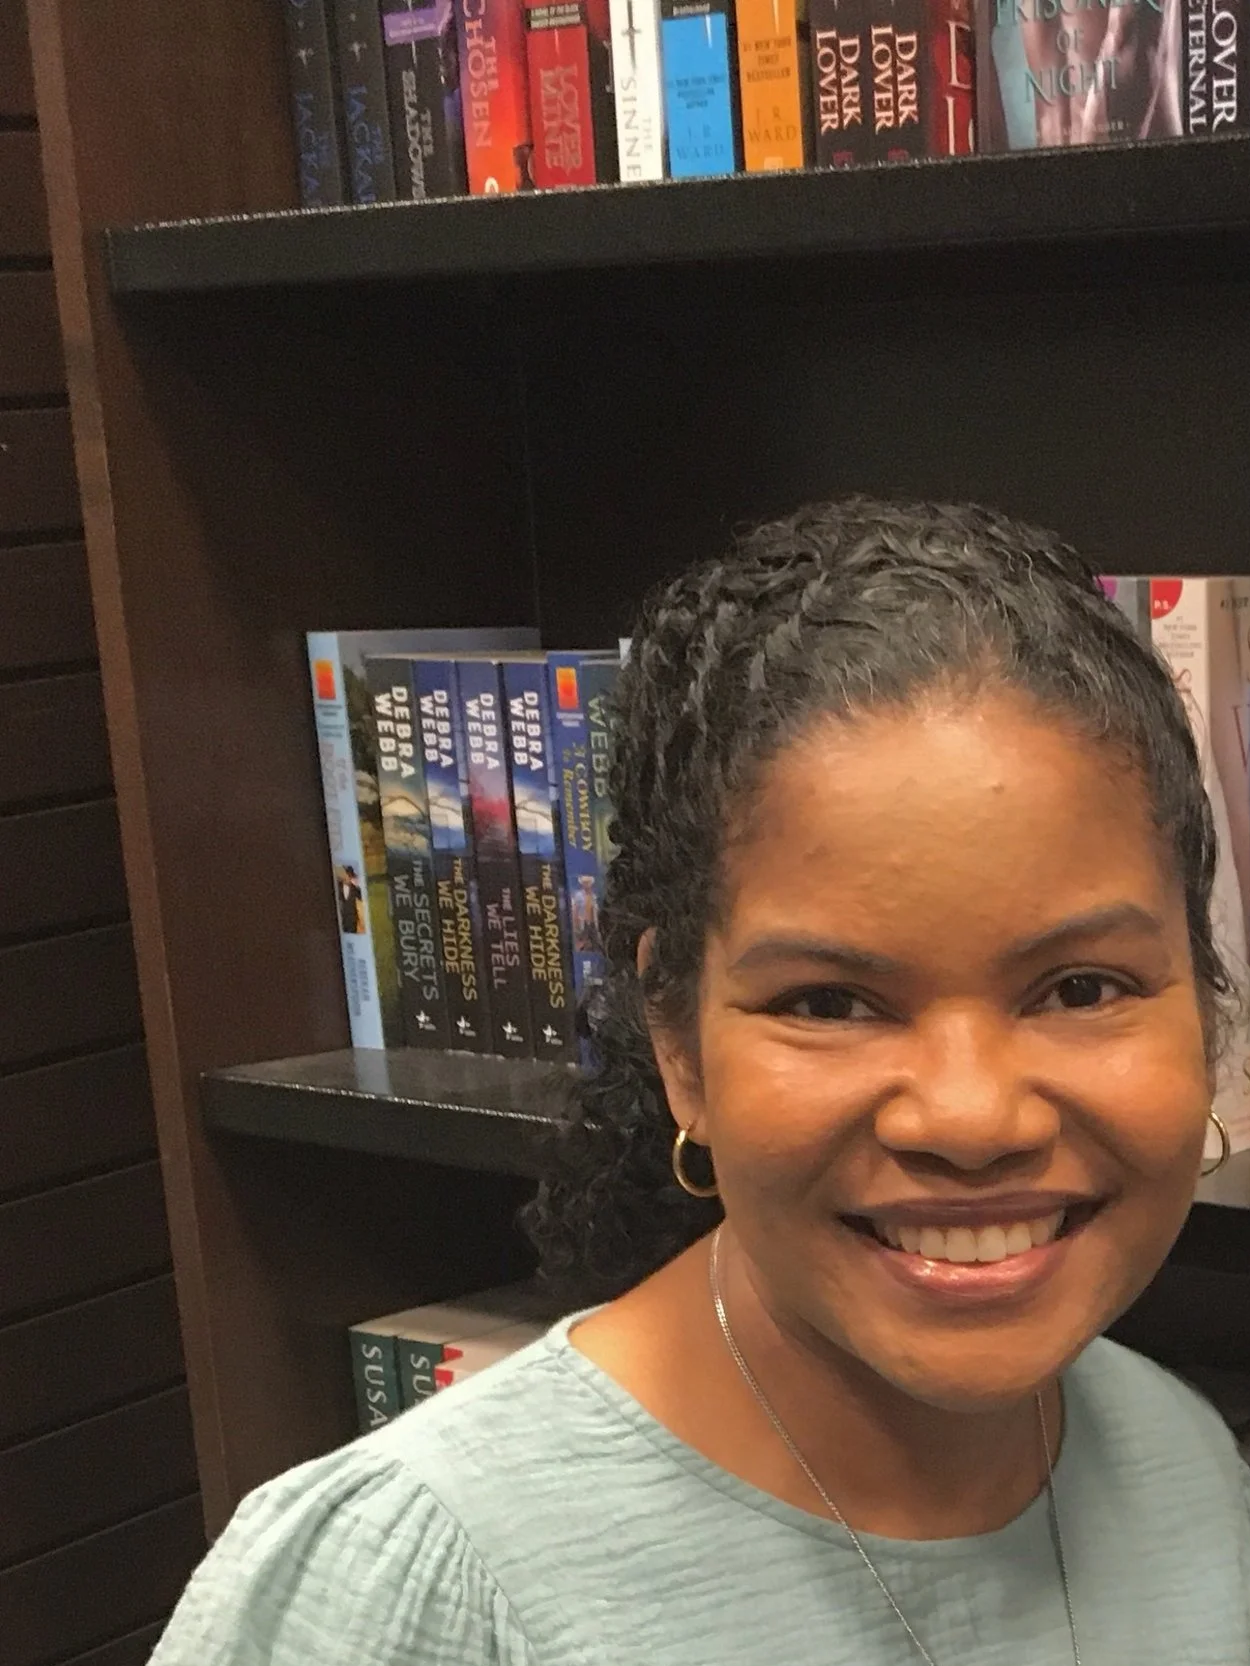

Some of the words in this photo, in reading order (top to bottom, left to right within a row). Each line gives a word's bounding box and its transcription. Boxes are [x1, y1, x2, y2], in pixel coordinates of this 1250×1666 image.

[485, 36, 499, 92] THE
[816, 28, 839, 136] LOVER
[839, 35, 862, 130] DARK
[871, 24, 894, 136] LOVER
[895, 31, 919, 128] DARK
[1023, 54, 1122, 107] NIGHT
[374, 692, 398, 772] WEBB
[391, 685, 417, 779] DEBRA
[419, 695, 440, 763] WEBB
[432, 689, 455, 769] DEBRA
[465, 698, 484, 765] WEBB
[479, 692, 500, 771] DEBRA
[509, 697, 528, 766] WEBB
[523, 691, 543, 772] DEBRA
[562, 768, 578, 849] Remember
[574, 762, 594, 852] COWBOY
[393, 873, 410, 908] WE
[436, 878, 453, 912] WE
[486, 902, 502, 931] WE
[525, 885, 541, 916] WE
[397, 919, 420, 984] BURY
[412, 891, 440, 1001] SECRETS
[440, 918, 461, 974] HIDE
[453, 888, 478, 1003] DARKNESS
[490, 943, 507, 989] TELL
[503, 914, 519, 968] LIES
[527, 922, 548, 982] HIDE
[541, 893, 565, 1009] DARKNESS
